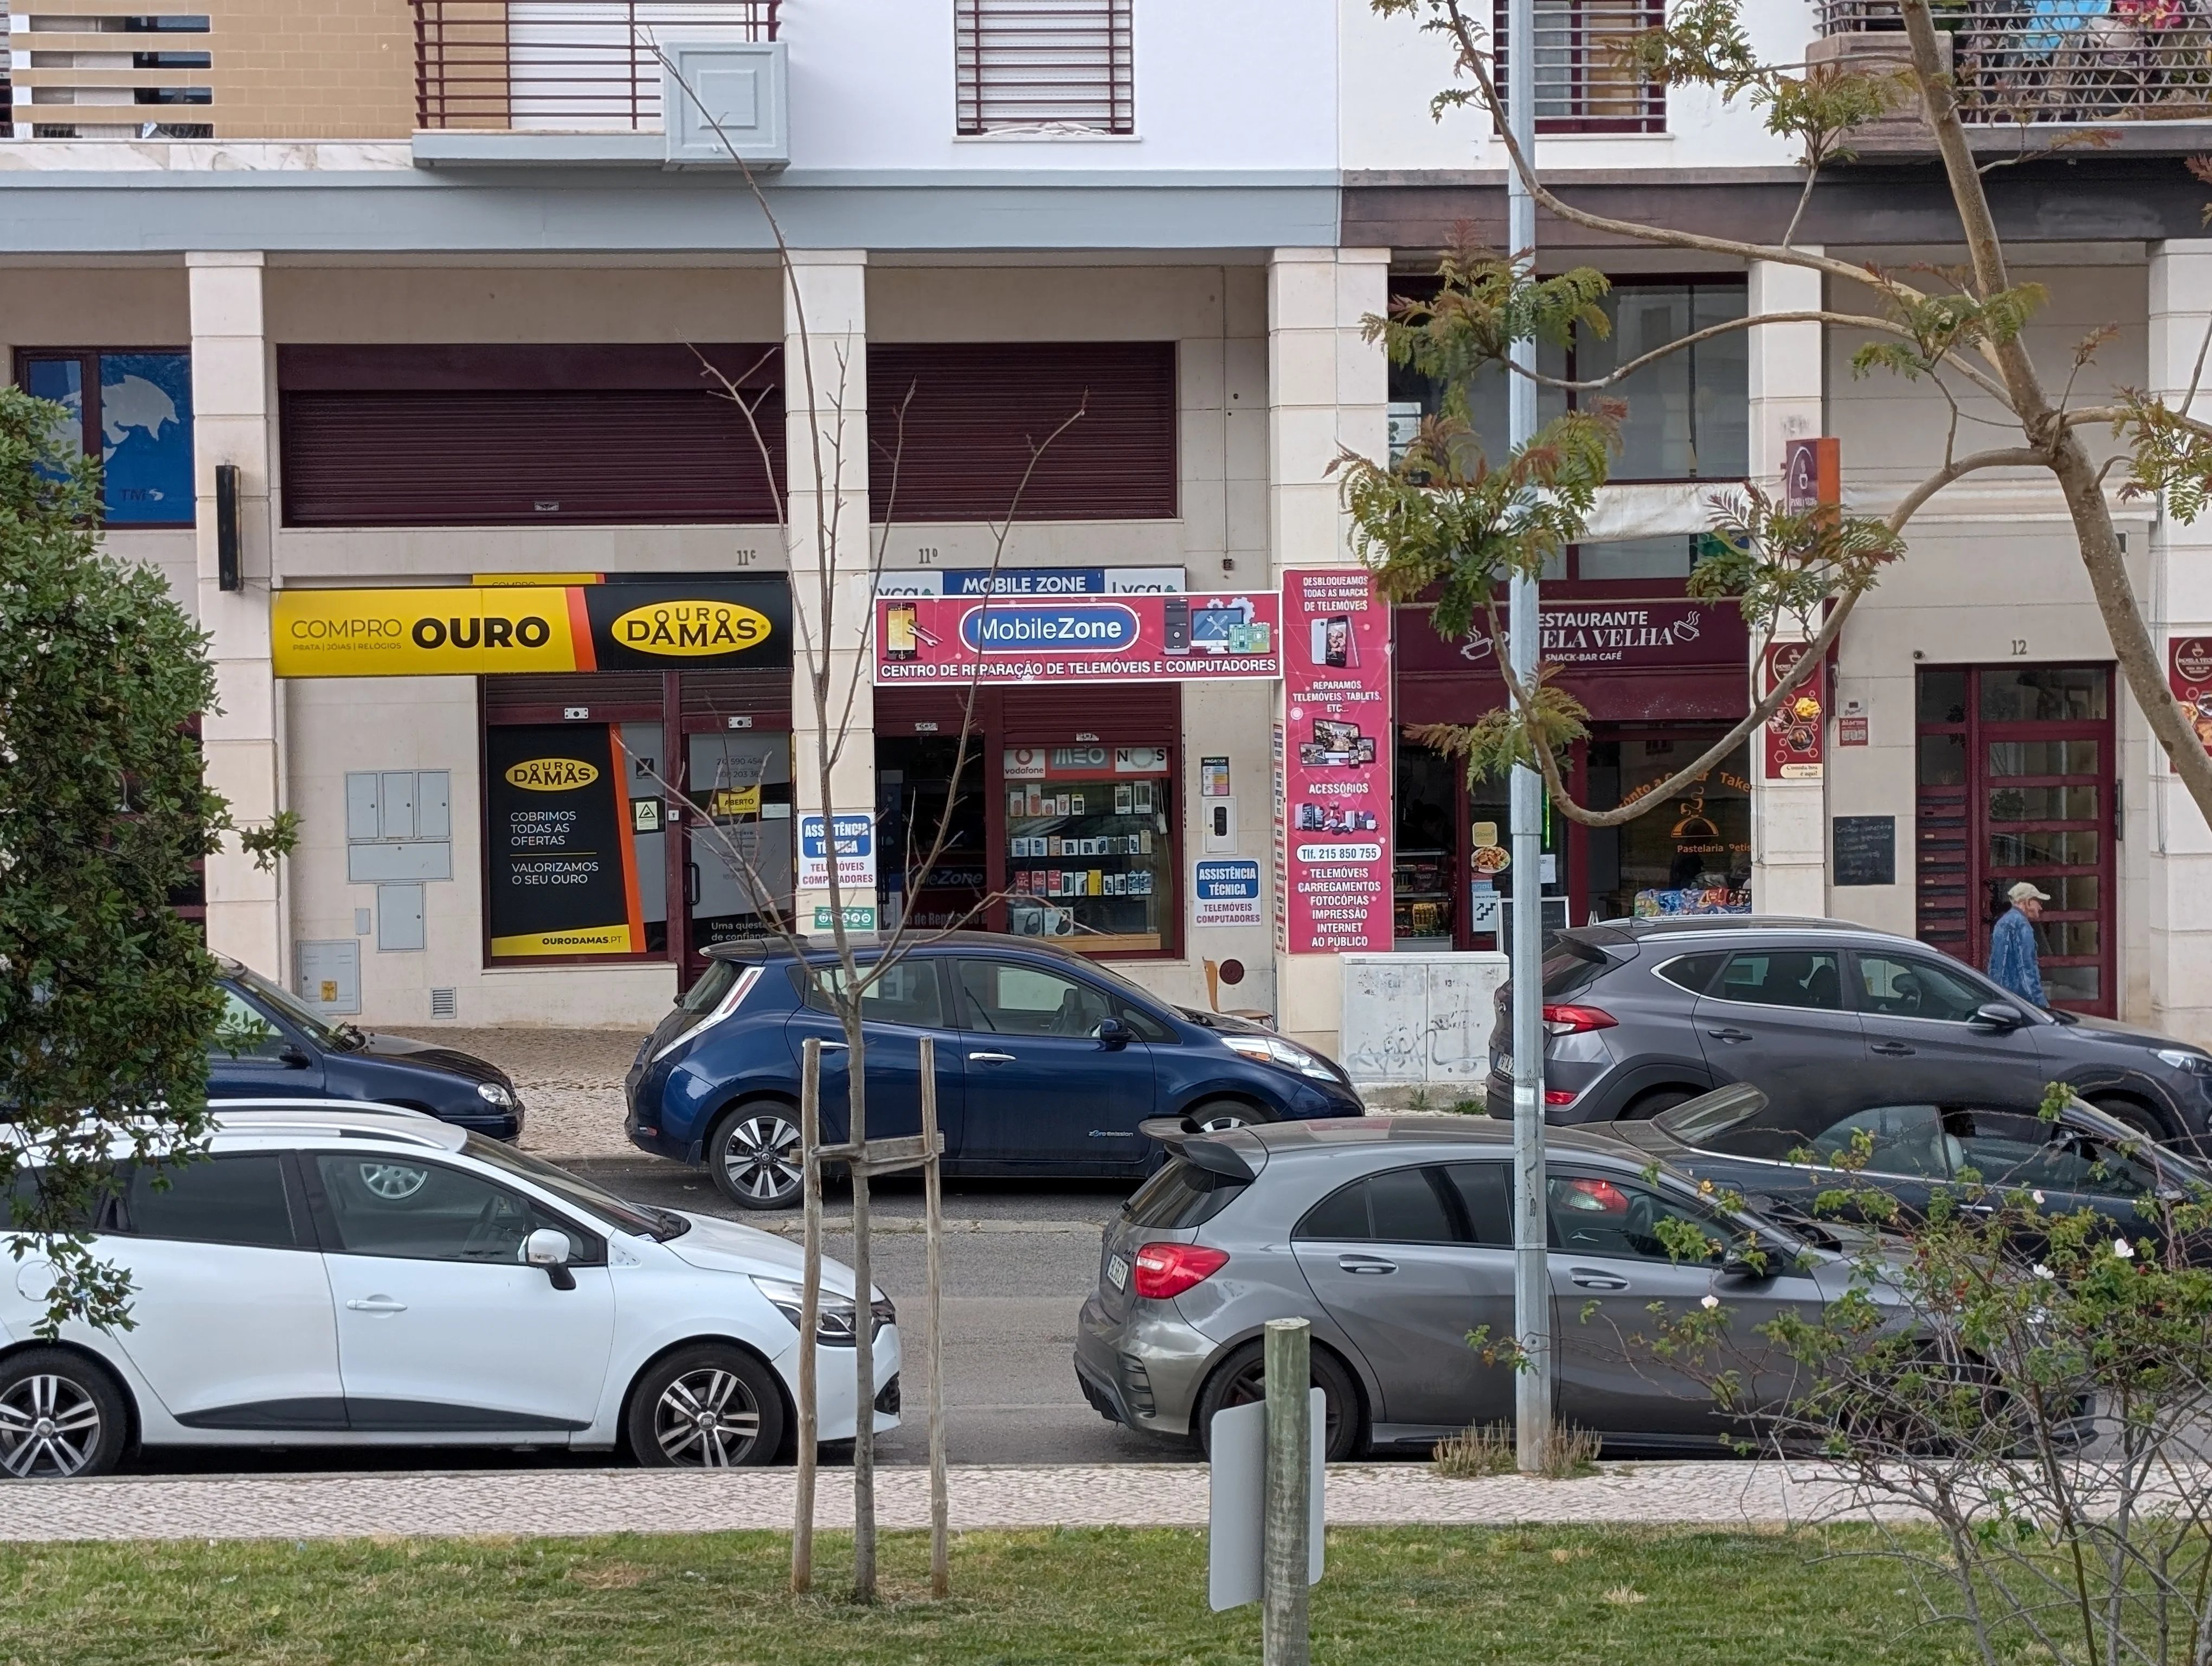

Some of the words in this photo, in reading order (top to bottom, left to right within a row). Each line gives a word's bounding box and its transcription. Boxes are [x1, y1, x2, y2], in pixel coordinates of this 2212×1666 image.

[962, 576, 1031, 593] MOBILE
[1035, 576, 1086, 592] ZONE
[1303, 575, 1369, 587] DESBLOQUEAMOS
[1303, 588, 1326, 598] TODAS
[1327, 588, 1338, 598] AS
[1339, 587, 1369, 598] MARCAS
[1304, 601, 1315, 612] DE
[1318, 599, 1368, 612] TELEMÓVEIS
[654, 607, 731, 624] OURO
[291, 619, 402, 639] COMPRO
[411, 617, 550, 649] OURO
[627, 618, 757, 648] DAMAS
[977, 617, 1122, 640] MobileZone
[1592, 627, 1674, 648] VELHA
[358, 642, 402, 650] RELÓGIOS
[2011, 640, 2027, 656] 12
[1545, 652, 1597, 662] SNACK-BAR
[1599, 651, 1622, 661] CAFÉ
[881, 664, 936, 677] CENTRO
[940, 663, 959, 676] DE
[961, 660, 1043, 678] REPARAÇÃO
[1046, 662, 1065, 675] DE
[1068, 658, 1150, 674] TELEMÓVEIS
[1154, 661, 1163, 673] E
[1166, 659, 1276, 673] COMPUTADORES
[1313, 680, 1362, 690] REPARAMOS
[1293, 690, 1345, 702] TELEMÓVEIS,
[1347, 691, 1382, 701] TABLETS,
[1055, 748, 1105, 765] MEO
[530, 762, 575, 771] OURO
[1005, 766, 1044, 774] vodafone
[514, 768, 591, 786] DAMAS
[1720, 771, 1751, 793] Take
[1309, 781, 1369, 794] ACESSÓRIOS
[724, 798, 754, 806] ABERTO
[511, 811, 577, 822] COBRIMOS
[511, 823, 552, 834] TODAS
[554, 823, 570, 833] AS
[511, 835, 565, 846] OFERTAS
[1302, 848, 1316, 860] Tlf.
[1319, 848, 1336, 859] 215
[1339, 848, 1356, 859] 850
[1360, 848, 1377, 858] 755
[1677, 843, 1724, 853] Pastelaria
[512, 862, 599, 873] VALORIZAMOS
[1199, 866, 1256, 880] ASSISTÊNCIA
[1310, 866, 1369, 878] TELEMÓVEIS
[512, 875, 522, 885] O
[524, 874, 548, 885] SEU
[551, 874, 588, 885] OURO
[1209, 882, 1247, 896] TÉCNICA
[1298, 881, 1381, 893] CARREGAMENTOS
[1310, 893, 1369, 907] FOTOCÓPIAS
[1204, 901, 1252, 912] TELEMÓVEIS
[1196, 913, 1261, 924] COMPUTADORES
[1312, 906, 1368, 920] IMPRESSÃO
[1317, 922, 1363, 933] INTERNET
[542, 935, 622, 945] OURODAMAS.PT
[1311, 936, 1327, 947] AO
[1328, 933, 1368, 947] PÚBLICO
